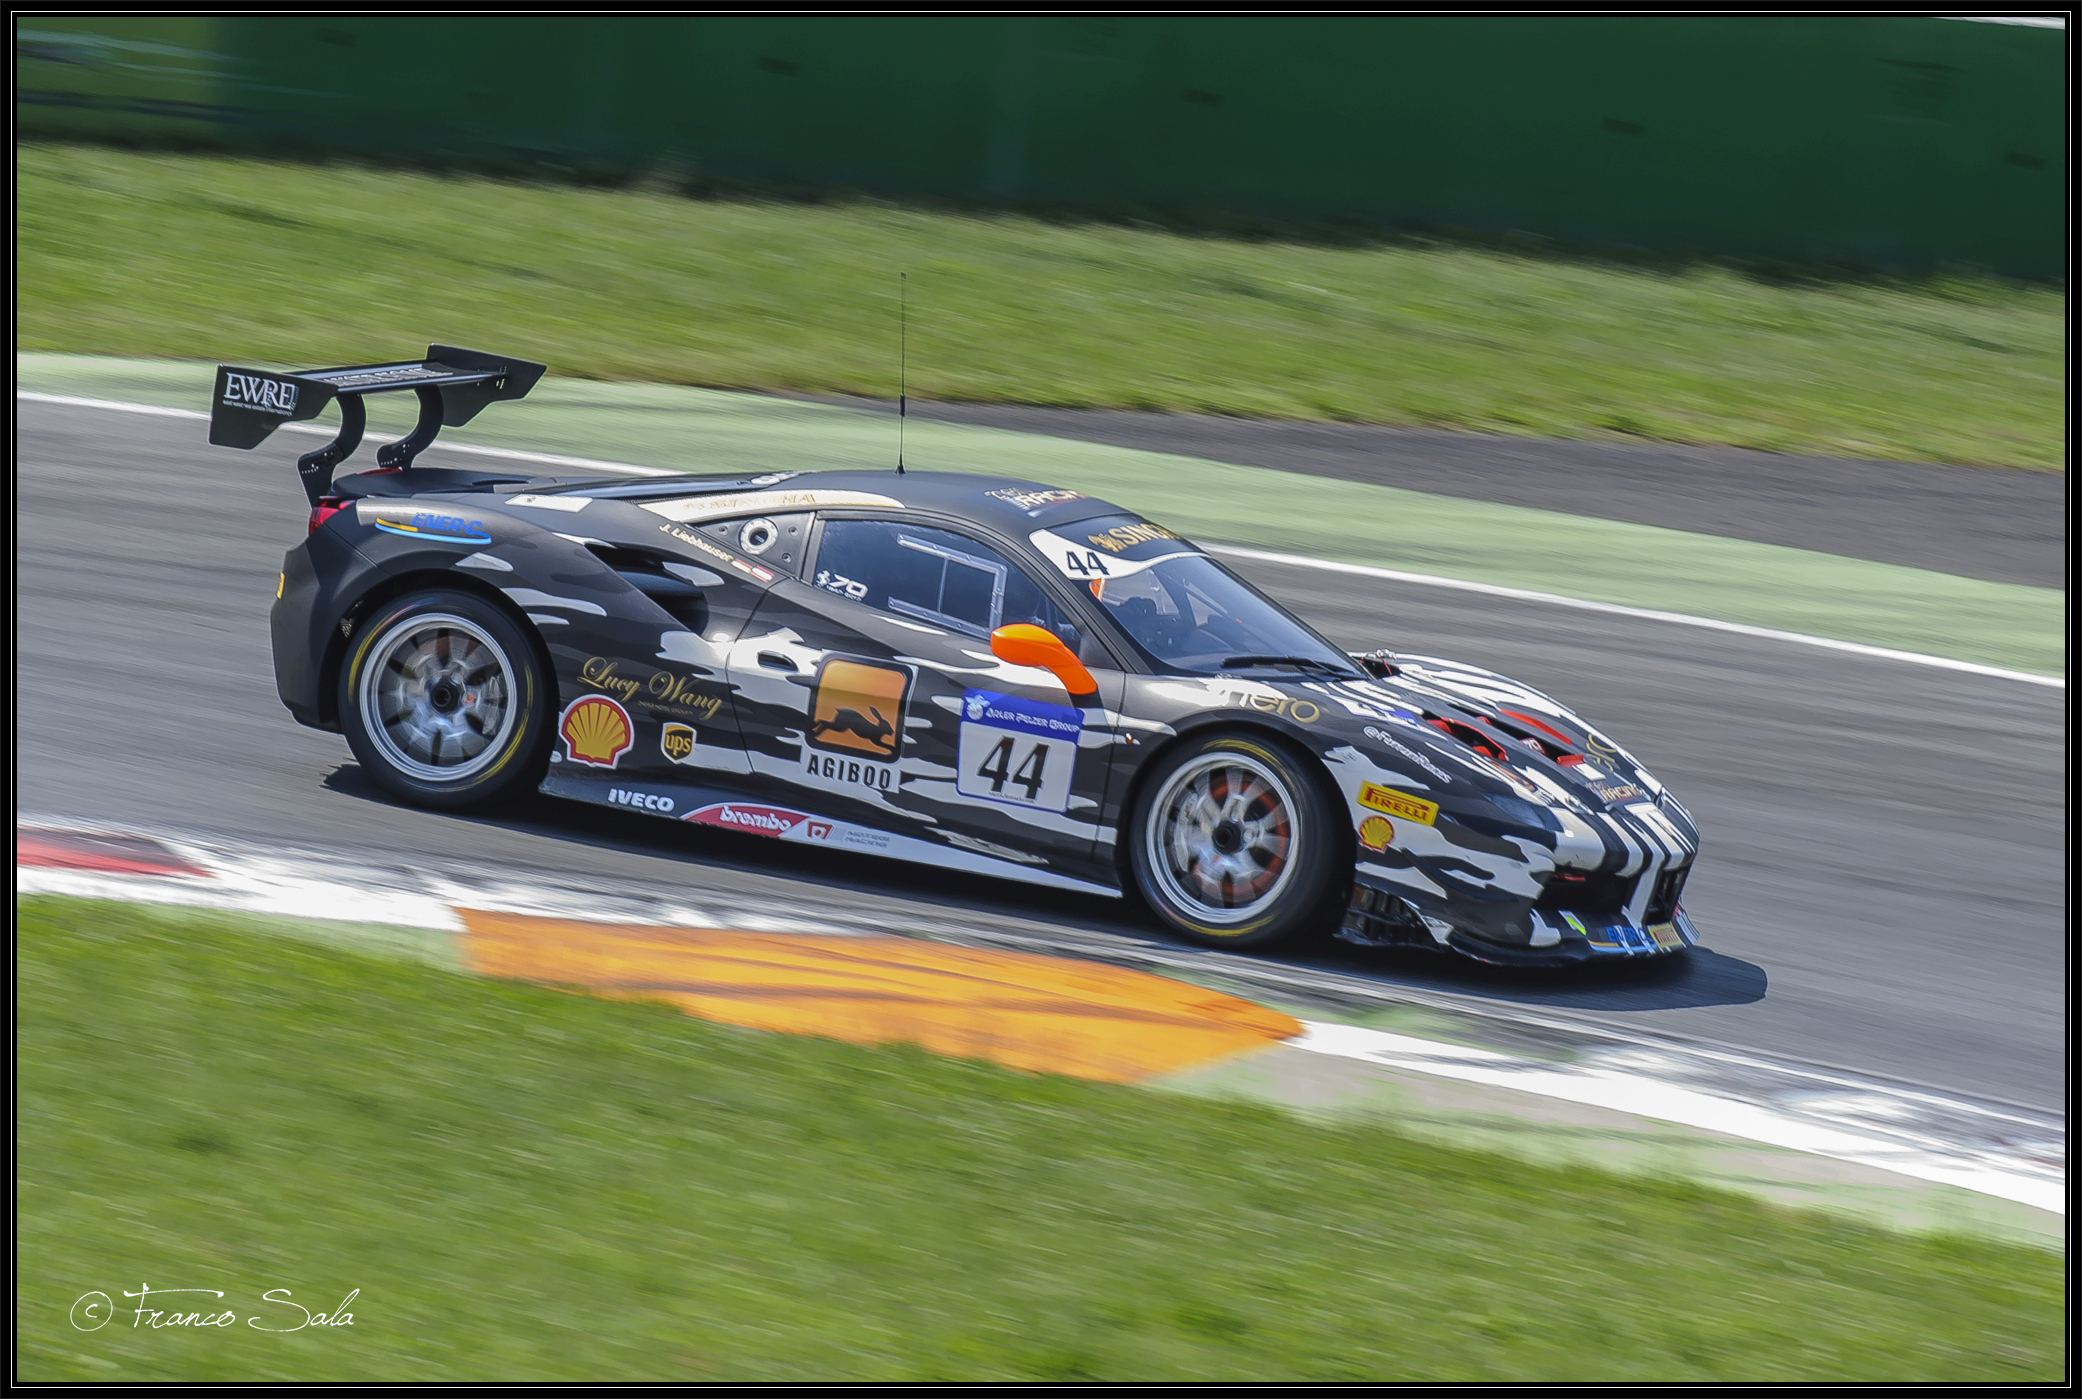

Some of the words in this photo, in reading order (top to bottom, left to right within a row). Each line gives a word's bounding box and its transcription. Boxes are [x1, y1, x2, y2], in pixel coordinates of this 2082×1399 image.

[224, 372, 296, 411] EWRE
[659, 523, 672, 534] J.
[1066, 551, 1109, 575] 44
[828, 573, 868, 598] 70
[577, 656, 640, 703] Lucy
[648, 671, 723, 721] Wang
[665, 735, 692, 757] ups
[806, 753, 892, 790] AGIBOO
[976, 734, 1051, 801] 44
[607, 788, 675, 812] IVECO
[1364, 786, 1430, 821] PIRELLI
[720, 805, 792, 832] brembo
